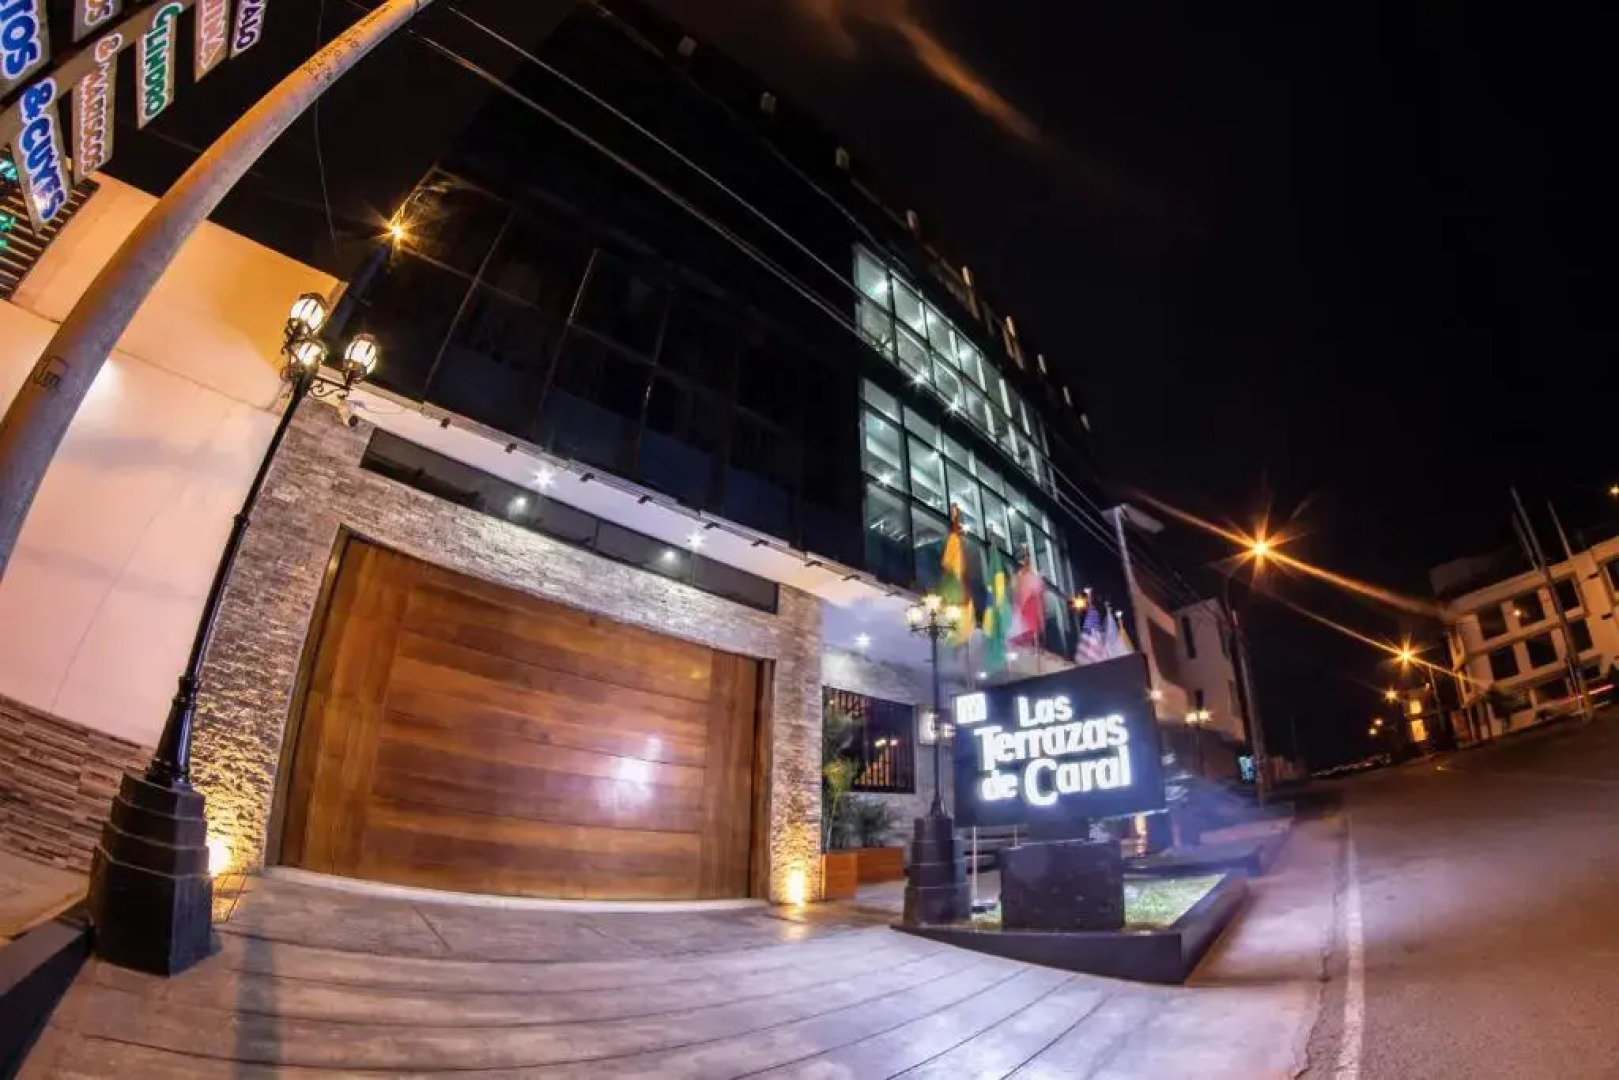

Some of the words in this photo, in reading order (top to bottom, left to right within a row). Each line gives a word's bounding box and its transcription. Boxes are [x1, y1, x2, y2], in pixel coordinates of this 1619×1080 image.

[0, 0, 41, 78] TOS
[235, 0, 265, 51] ALO
[1017, 695, 1074, 727] Las
[974, 714, 1130, 771] Terrazas
[981, 769, 1018, 801] de
[1024, 745, 1132, 806] Caral
